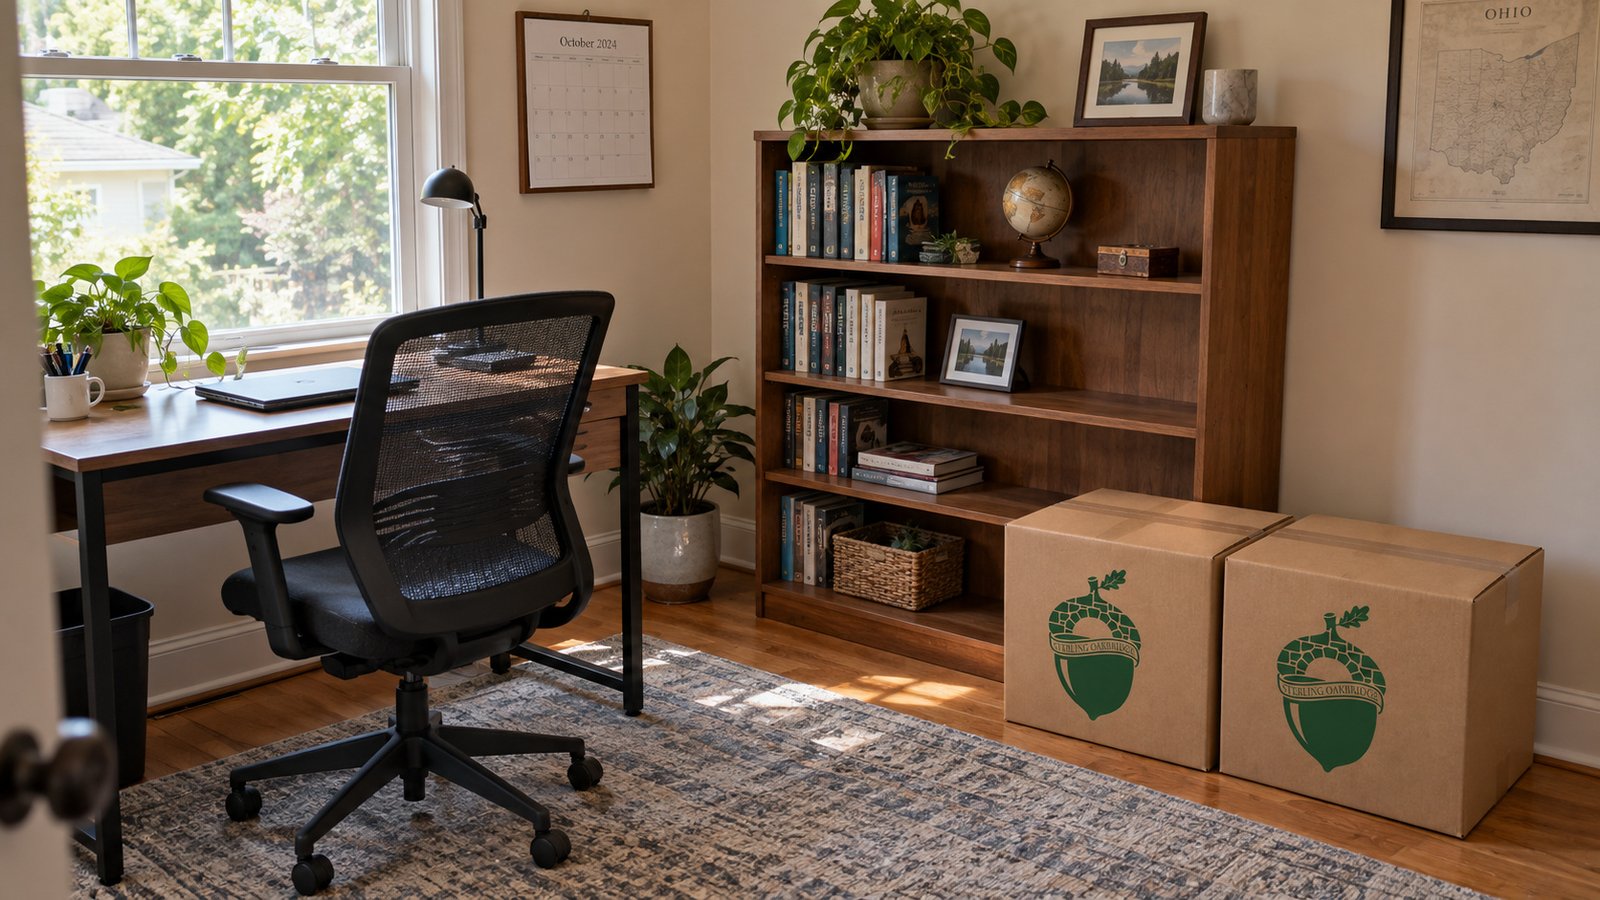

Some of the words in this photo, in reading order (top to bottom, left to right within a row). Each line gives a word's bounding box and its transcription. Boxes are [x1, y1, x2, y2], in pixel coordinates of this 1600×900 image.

[1485, 6, 1532, 20] OHIO
[560, 36, 594, 48] October
[597, 39, 616, 49] 2024
[1282, 684, 1324, 696] STERLING
